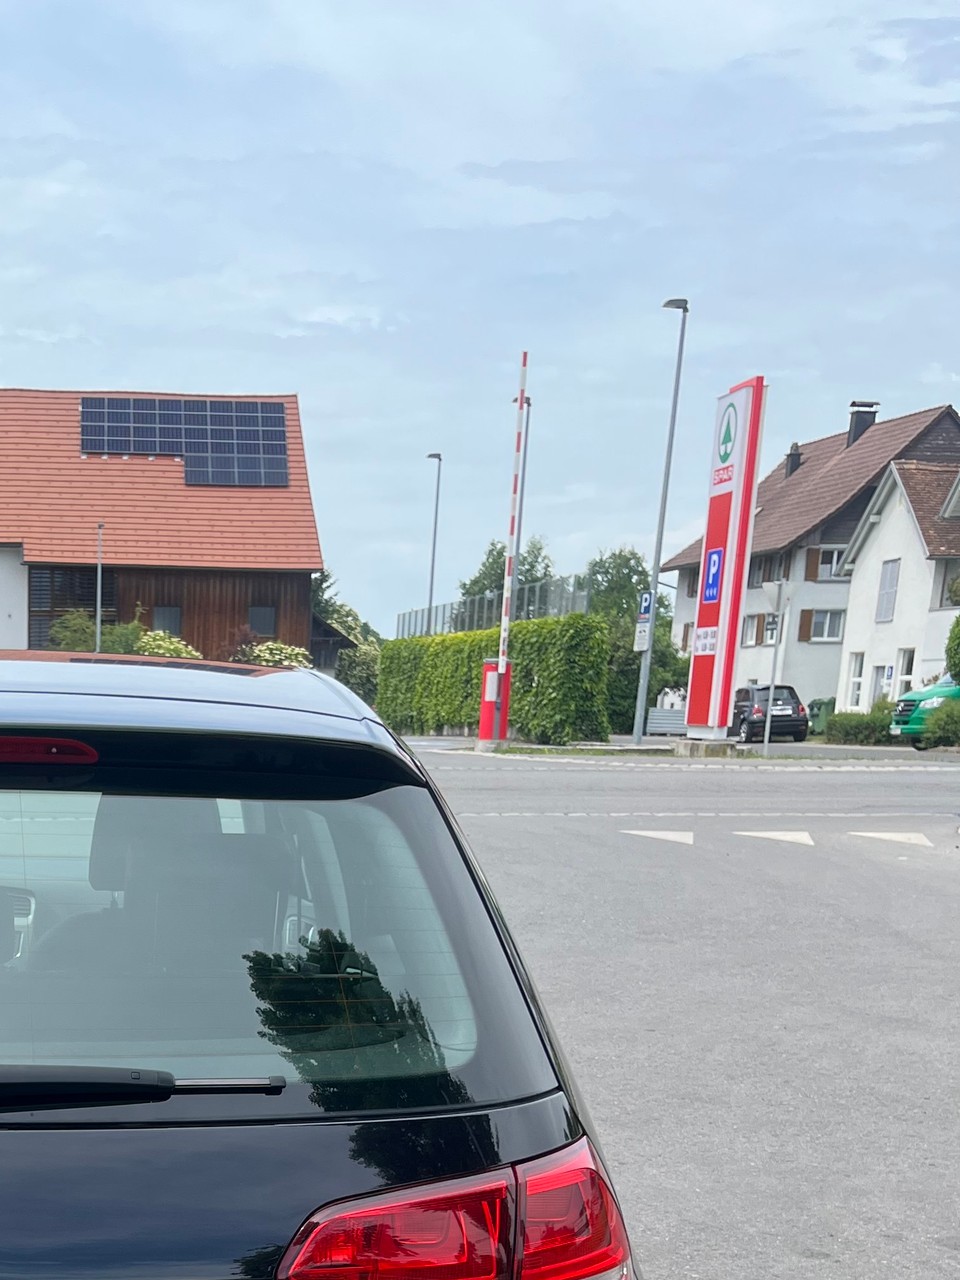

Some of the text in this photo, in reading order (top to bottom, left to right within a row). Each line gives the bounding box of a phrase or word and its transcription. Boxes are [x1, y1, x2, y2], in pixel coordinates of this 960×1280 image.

[713, 466, 733, 484] SPAR
[708, 553, 720, 585] P
[640, 593, 650, 614] P
